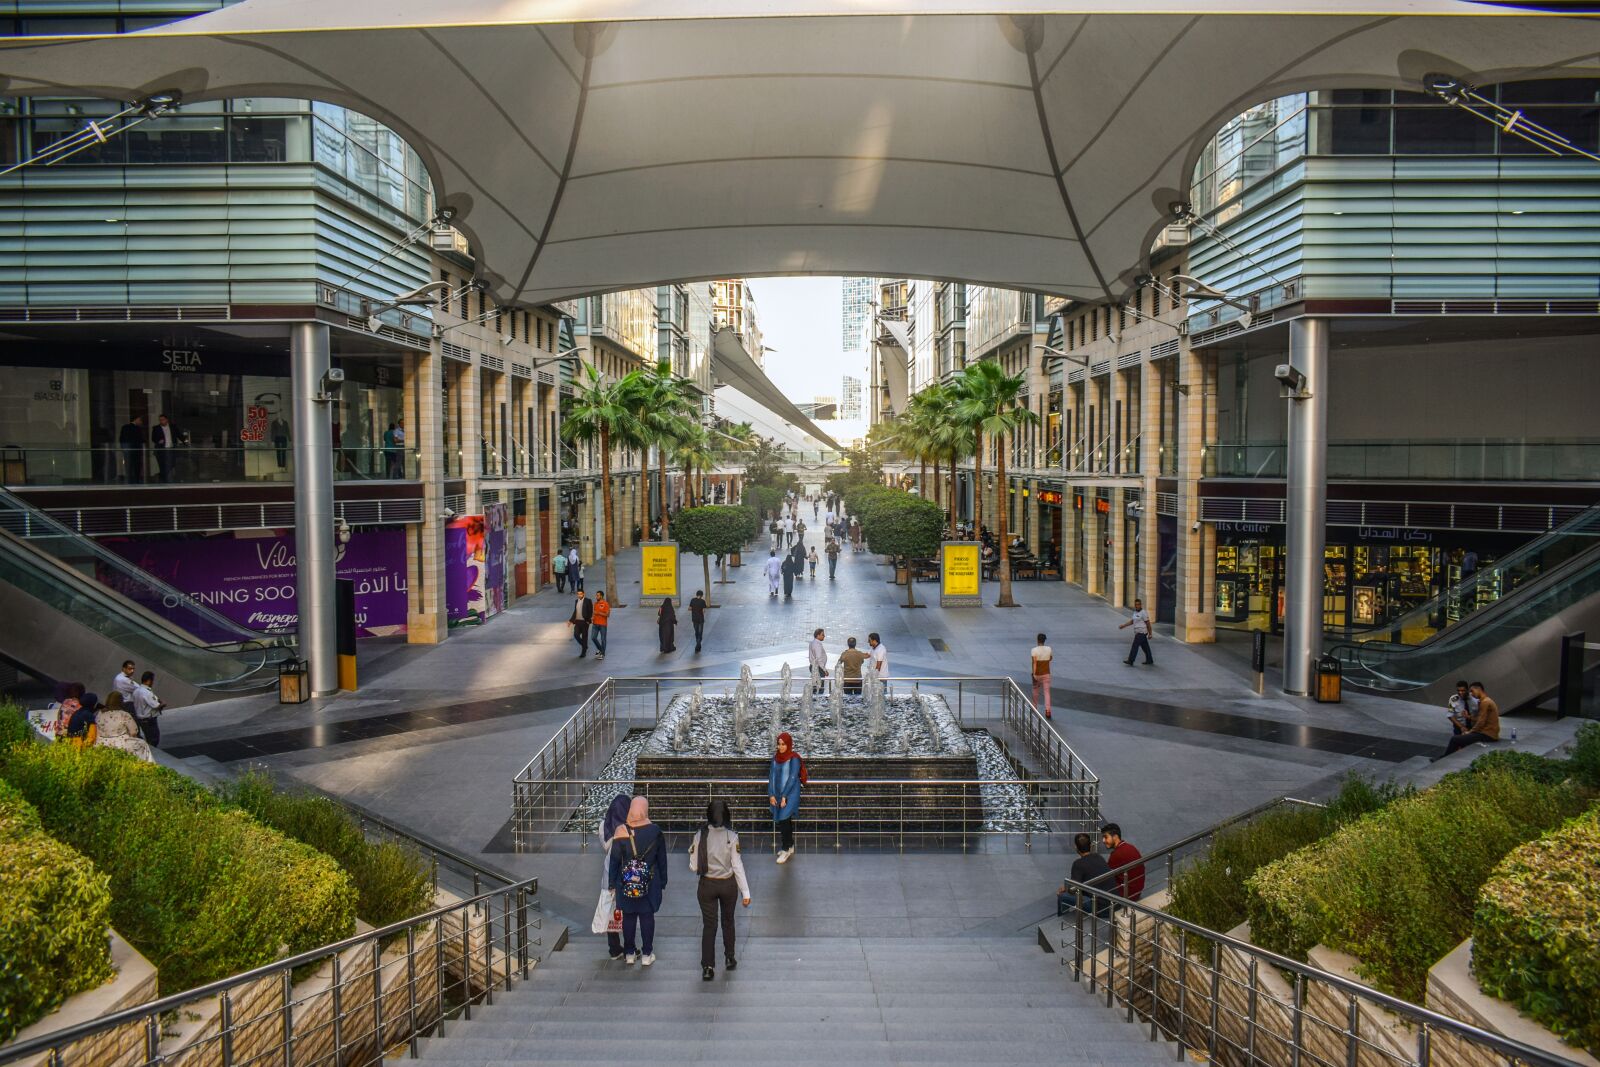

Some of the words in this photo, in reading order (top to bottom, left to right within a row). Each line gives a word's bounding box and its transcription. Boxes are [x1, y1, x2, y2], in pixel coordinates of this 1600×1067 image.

[162, 350, 202, 365] SETA
[171, 363, 196, 372] Donna
[248, 405, 268, 419] 50
[241, 429, 264, 441] Sale
[1234, 522, 1271, 533] Center
[163, 588, 249, 608] OPENING
[255, 586, 295, 601] SOO
